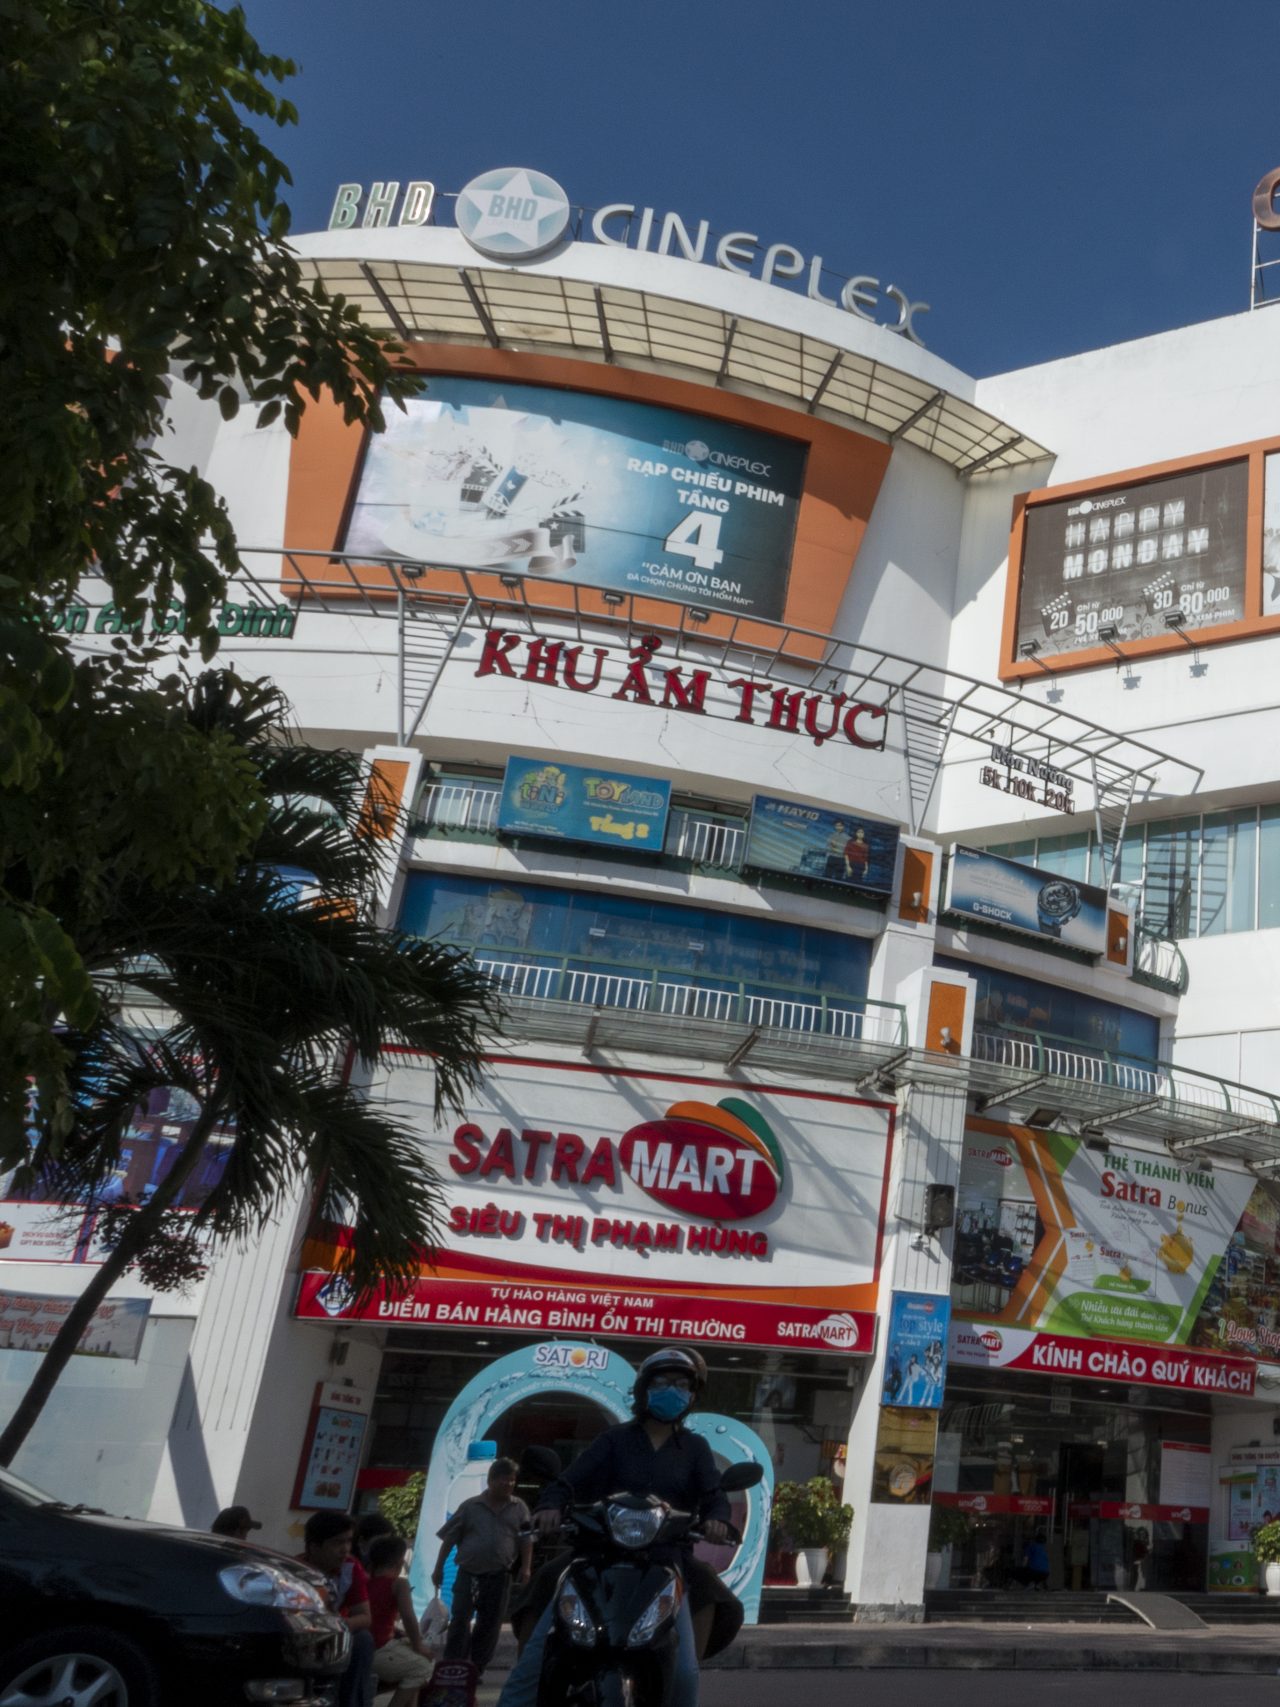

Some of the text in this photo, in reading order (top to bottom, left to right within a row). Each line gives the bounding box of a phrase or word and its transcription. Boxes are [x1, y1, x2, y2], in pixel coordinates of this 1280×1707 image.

[328, 180, 435, 231] BHD
[488, 194, 538, 221] BHD
[591, 203, 930, 346] CINEPLEX
[627, 458, 785, 506] RẠP CHIẾU PHIM
[708, 451, 772, 477] CINEPLEX
[665, 511, 724, 570] 4
[1067, 500, 1185, 549] HAPPY
[1063, 528, 1208, 580] MONDAY
[710, 577, 741, 594] BẠN
[1153, 589, 1173, 610] 3D
[216, 600, 295, 638] Đình
[1050, 611, 1069, 630] 2D
[474, 627, 609, 692] KHU
[728, 679, 887, 751] THỰC
[972, 902, 1013, 921] G-SHOCK
[448, 1122, 764, 1198] SATRA MART
[1102, 1153, 1216, 1190] THẺ THÀNH VIÊN
[1100, 1171, 1162, 1208] Satra
[1167, 1194, 1209, 1217] Bonus
[447, 1203, 768, 1257] SIÊU THỊ PHẠM HÙNG
[1099, 1246, 1121, 1259] Satra
[490, 1284, 654, 1310] TỰ HÀO HÀNG VIỆT NAM
[378, 1295, 430, 1319] ĐIỂM
[435, 1300, 480, 1323] BÁN
[485, 1303, 542, 1326] HÀNG
[547, 1307, 596, 1329] BÌNH
[633, 1316, 665, 1336] THỊ
[669, 1315, 746, 1341] TRƯỜNG
[777, 1321, 857, 1342] SATRA MART
[1226, 1318, 1256, 1350] Love
[1033, 1339, 1252, 1392] KÍNH CHÀO QUÝ KHÁCH
